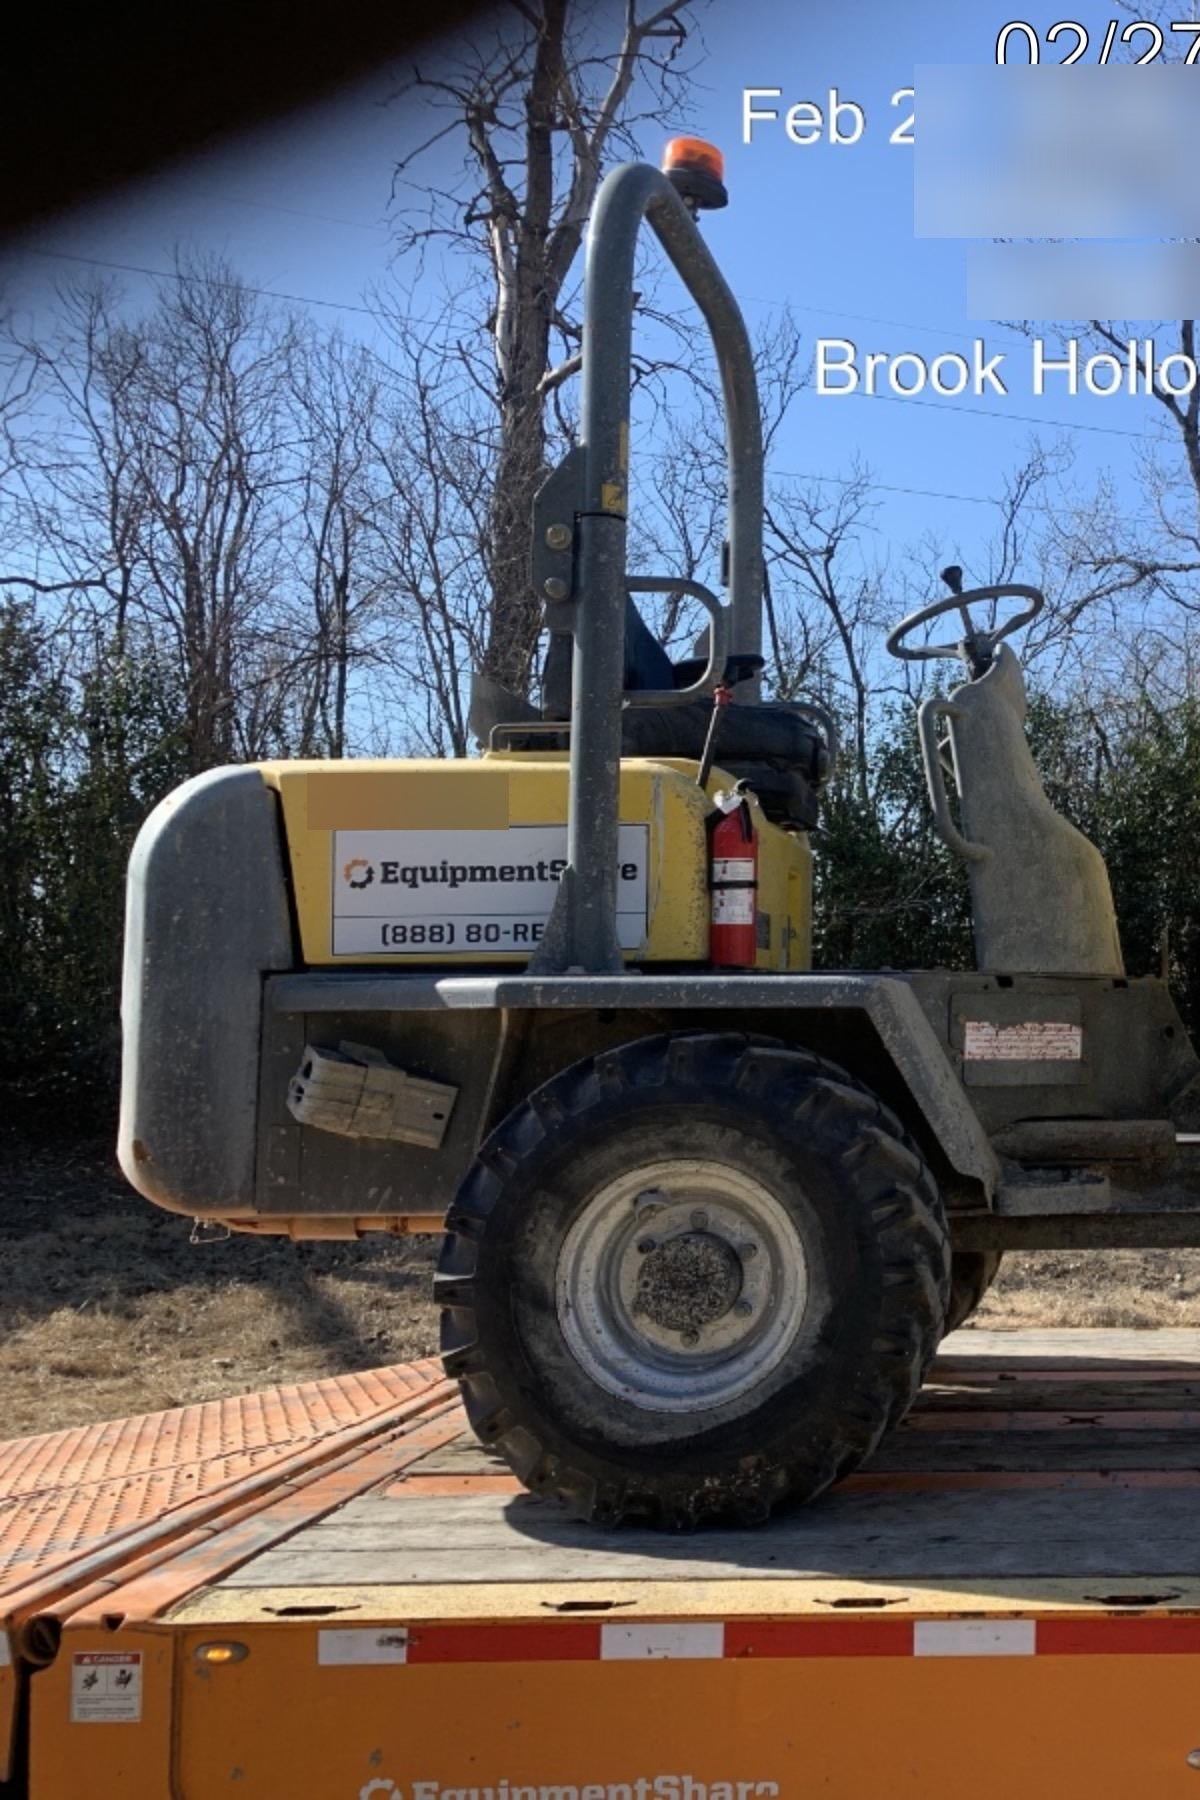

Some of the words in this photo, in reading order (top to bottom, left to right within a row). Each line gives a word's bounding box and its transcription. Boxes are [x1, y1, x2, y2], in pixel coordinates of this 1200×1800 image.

[380, 859, 638, 888] EquipmentSe
[381, 924, 455, 945] (888)
[465, 923, 545, 943] 80-RE
